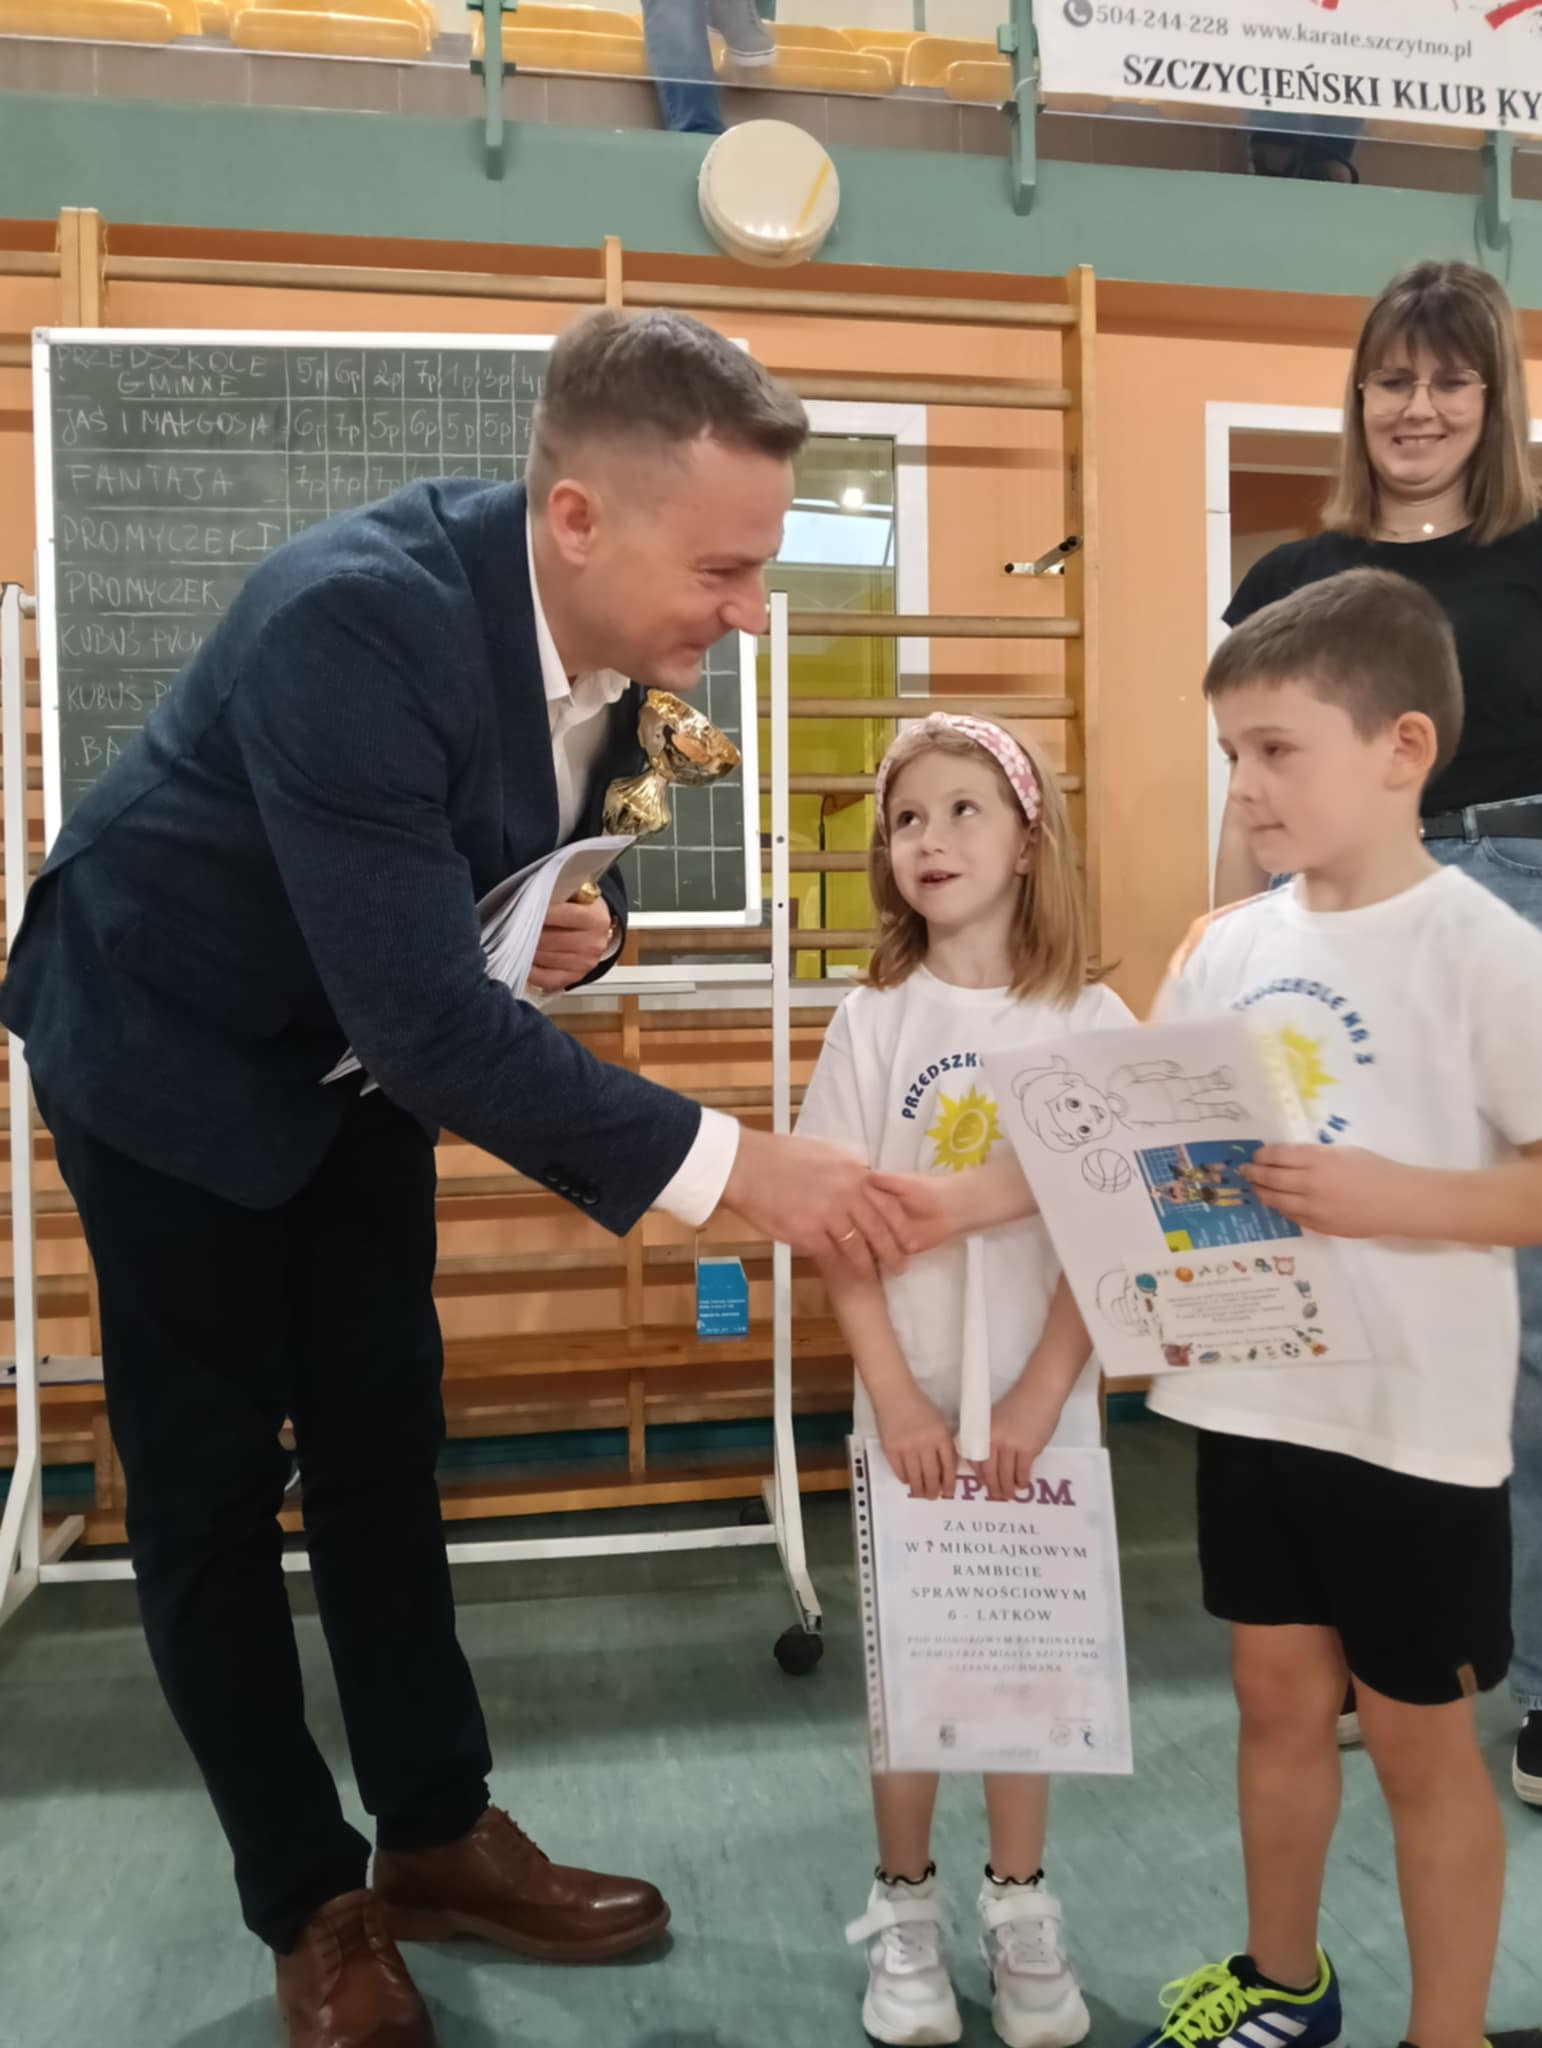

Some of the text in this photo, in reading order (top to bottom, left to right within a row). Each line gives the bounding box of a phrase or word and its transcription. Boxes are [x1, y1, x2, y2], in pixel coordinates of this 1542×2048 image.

[1242, 20, 1473, 61] www.karate.szczytno.pl
[1122, 53, 1381, 108] SZCZYCIEŃSKI
[1393, 77, 1486, 116] KLUB
[902, 1052, 984, 1120] PRZEDSZK
[944, 1519, 966, 1533] ZA
[905, 1541, 920, 1553] W
